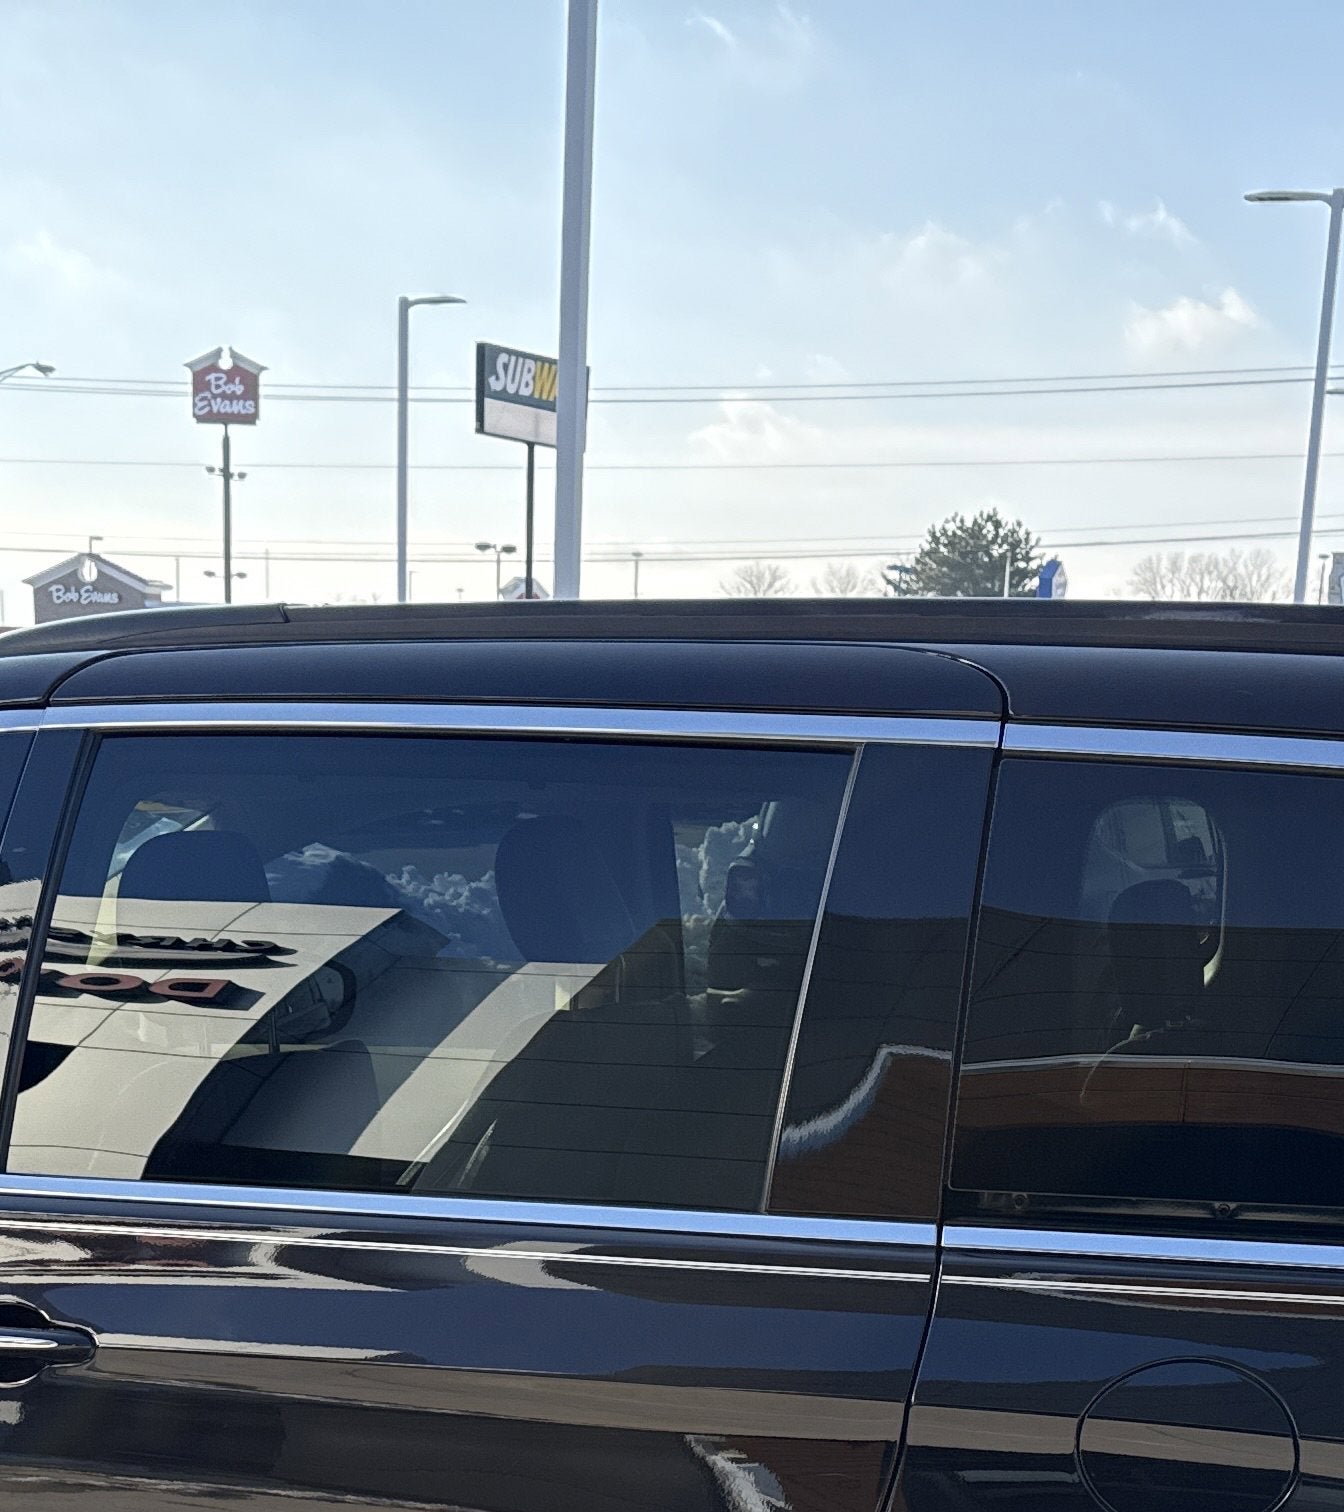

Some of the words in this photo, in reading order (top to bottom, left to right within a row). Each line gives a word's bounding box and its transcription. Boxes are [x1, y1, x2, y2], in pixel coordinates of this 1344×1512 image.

[205, 372, 245, 395] Bob
[488, 352, 559, 402] SUBW
[194, 391, 256, 415] Evans
[48, 583, 79, 604] Bob
[80, 585, 119, 605] Evans
